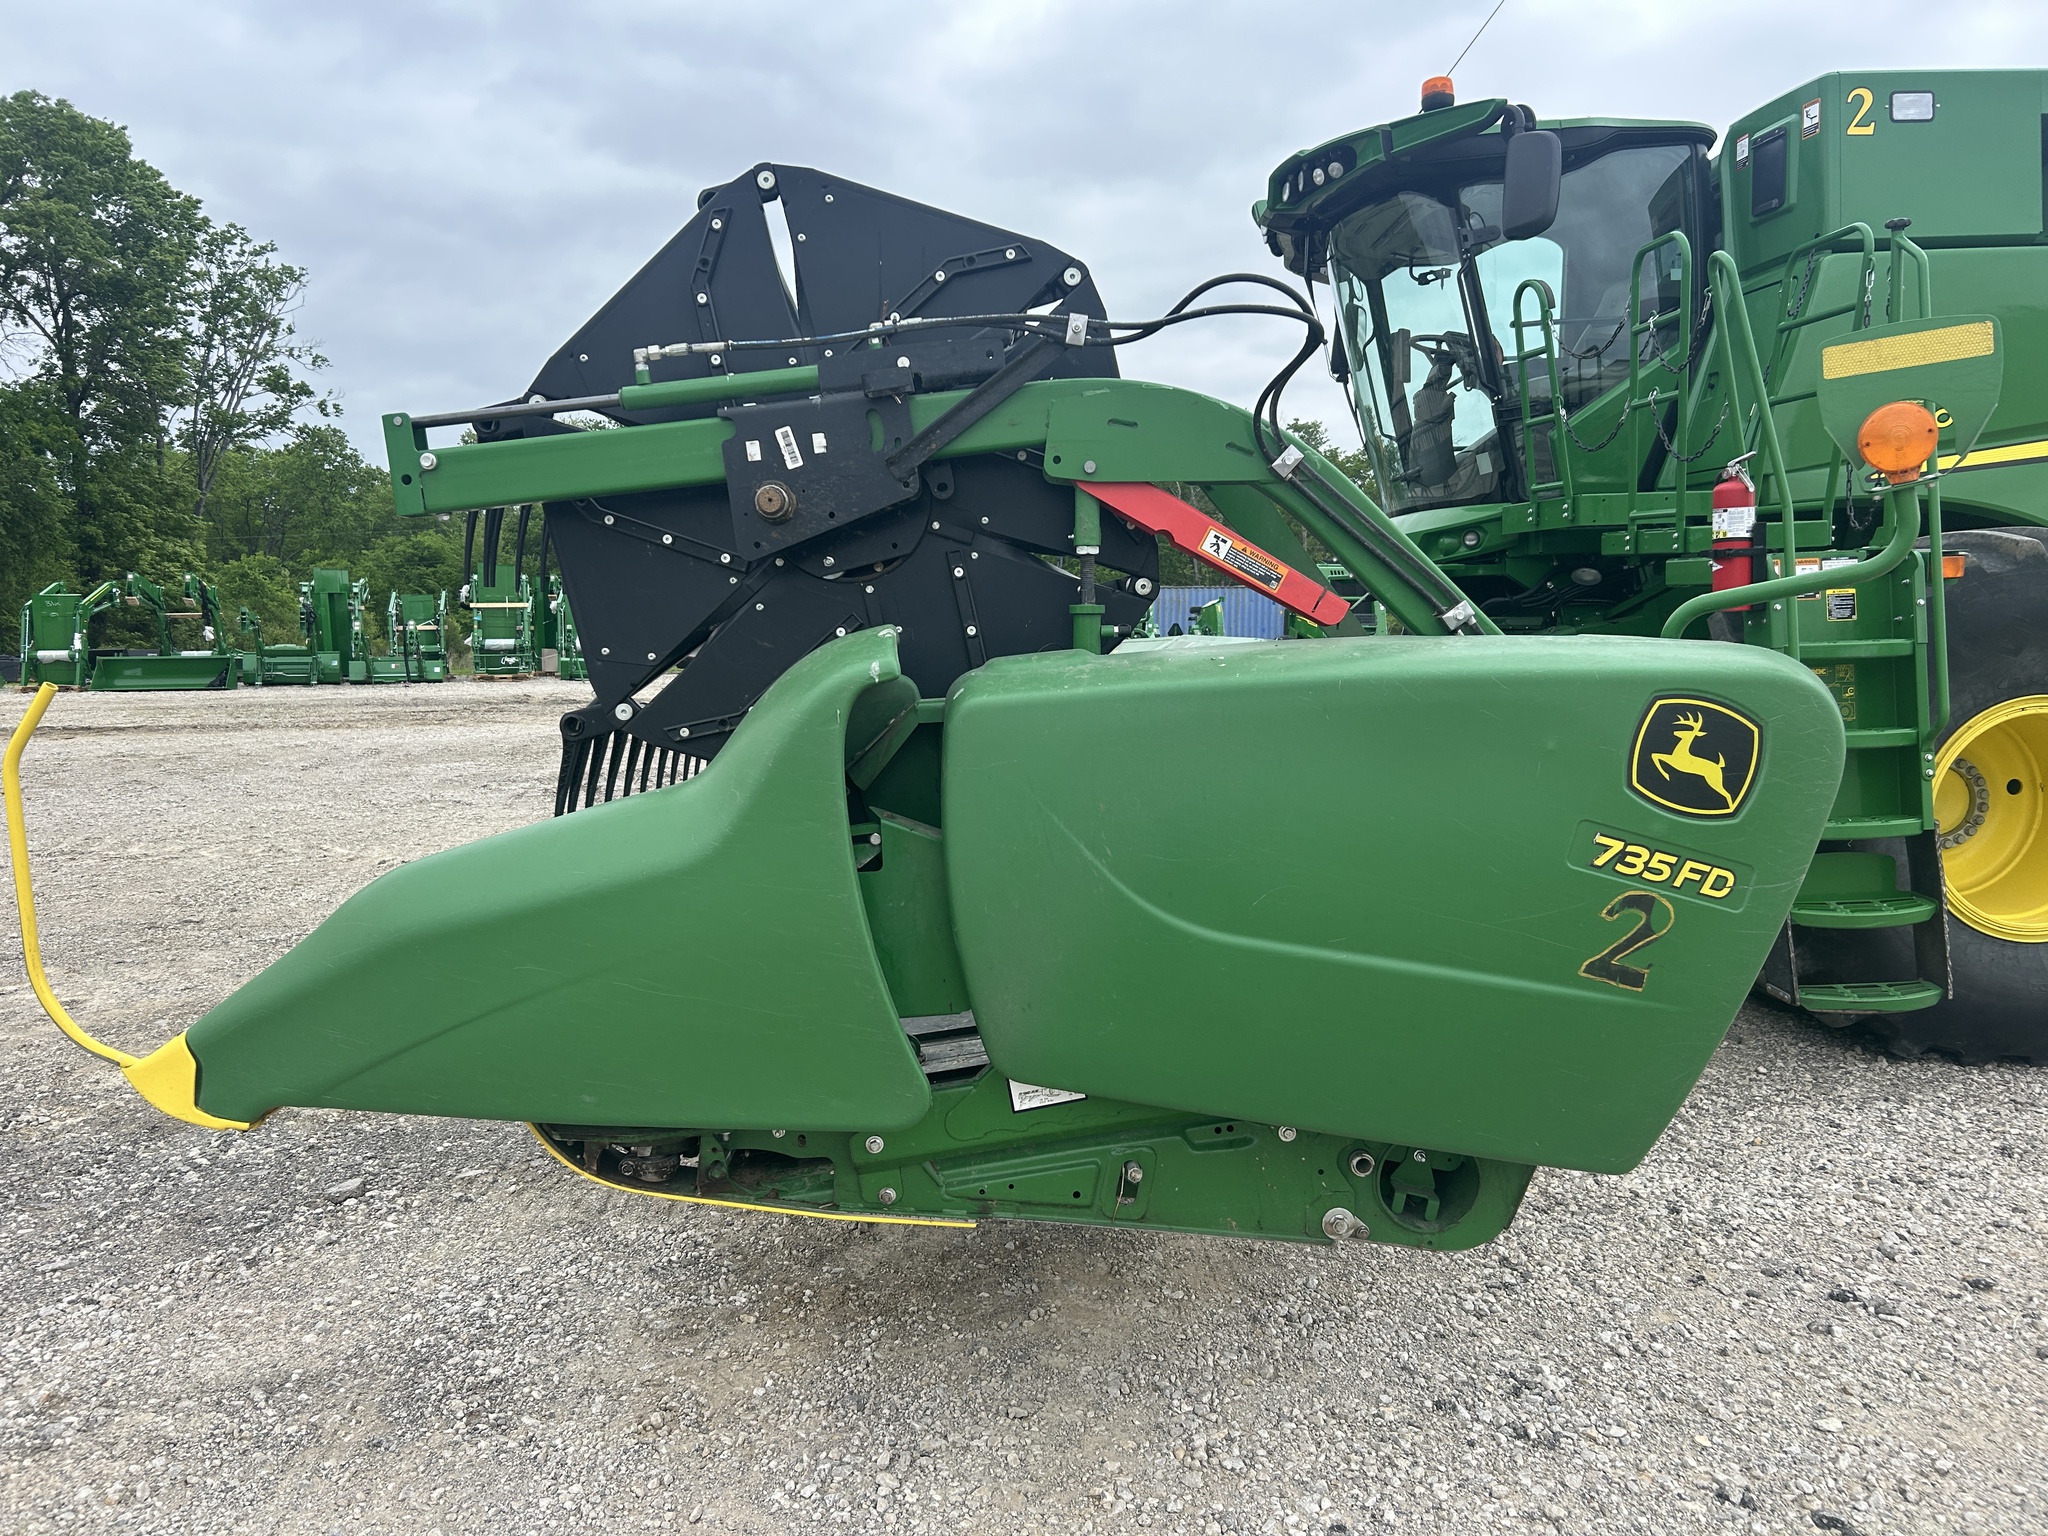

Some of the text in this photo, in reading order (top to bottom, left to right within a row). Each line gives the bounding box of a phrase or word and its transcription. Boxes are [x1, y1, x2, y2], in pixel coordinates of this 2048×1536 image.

[1845, 86, 1877, 137] 2
[1249, 549, 1280, 571] WARNING
[1577, 890, 1676, 993] 2
